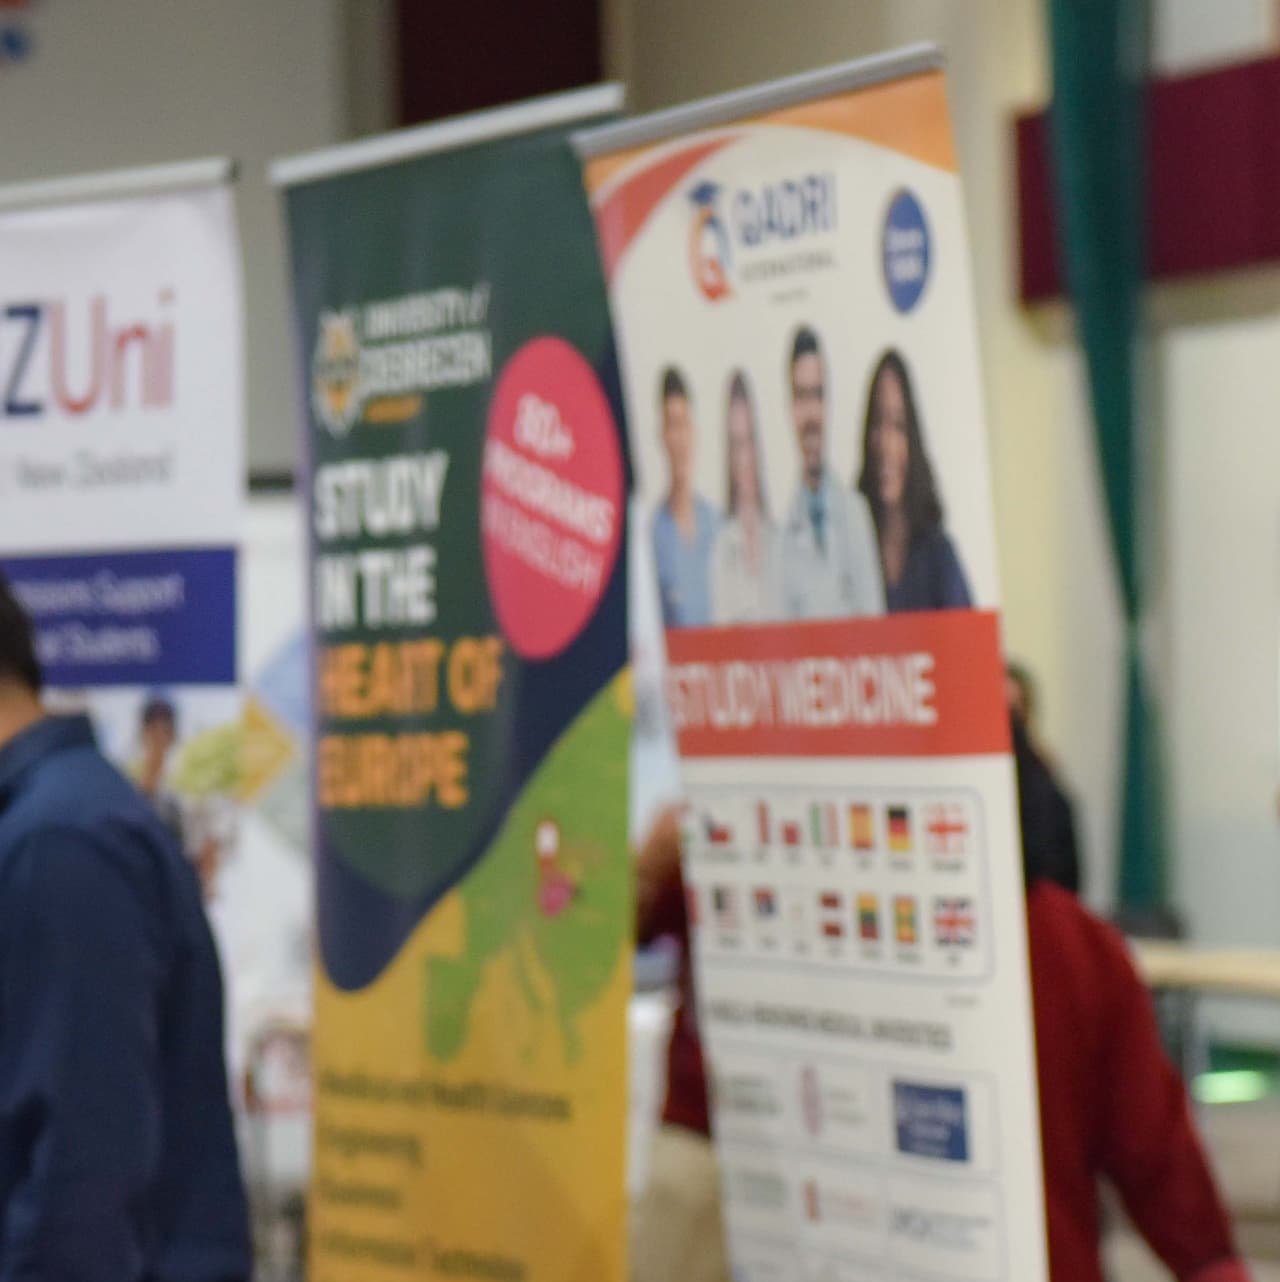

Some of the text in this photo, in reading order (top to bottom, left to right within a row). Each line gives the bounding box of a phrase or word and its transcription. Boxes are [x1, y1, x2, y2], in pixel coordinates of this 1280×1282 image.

[320, 453, 448, 535] STUDY
[359, 546, 436, 626] THE
[325, 638, 502, 717] HEART OF
[671, 653, 937, 728] STUDY MEDICINE
[325, 733, 468, 807] EUROPE
